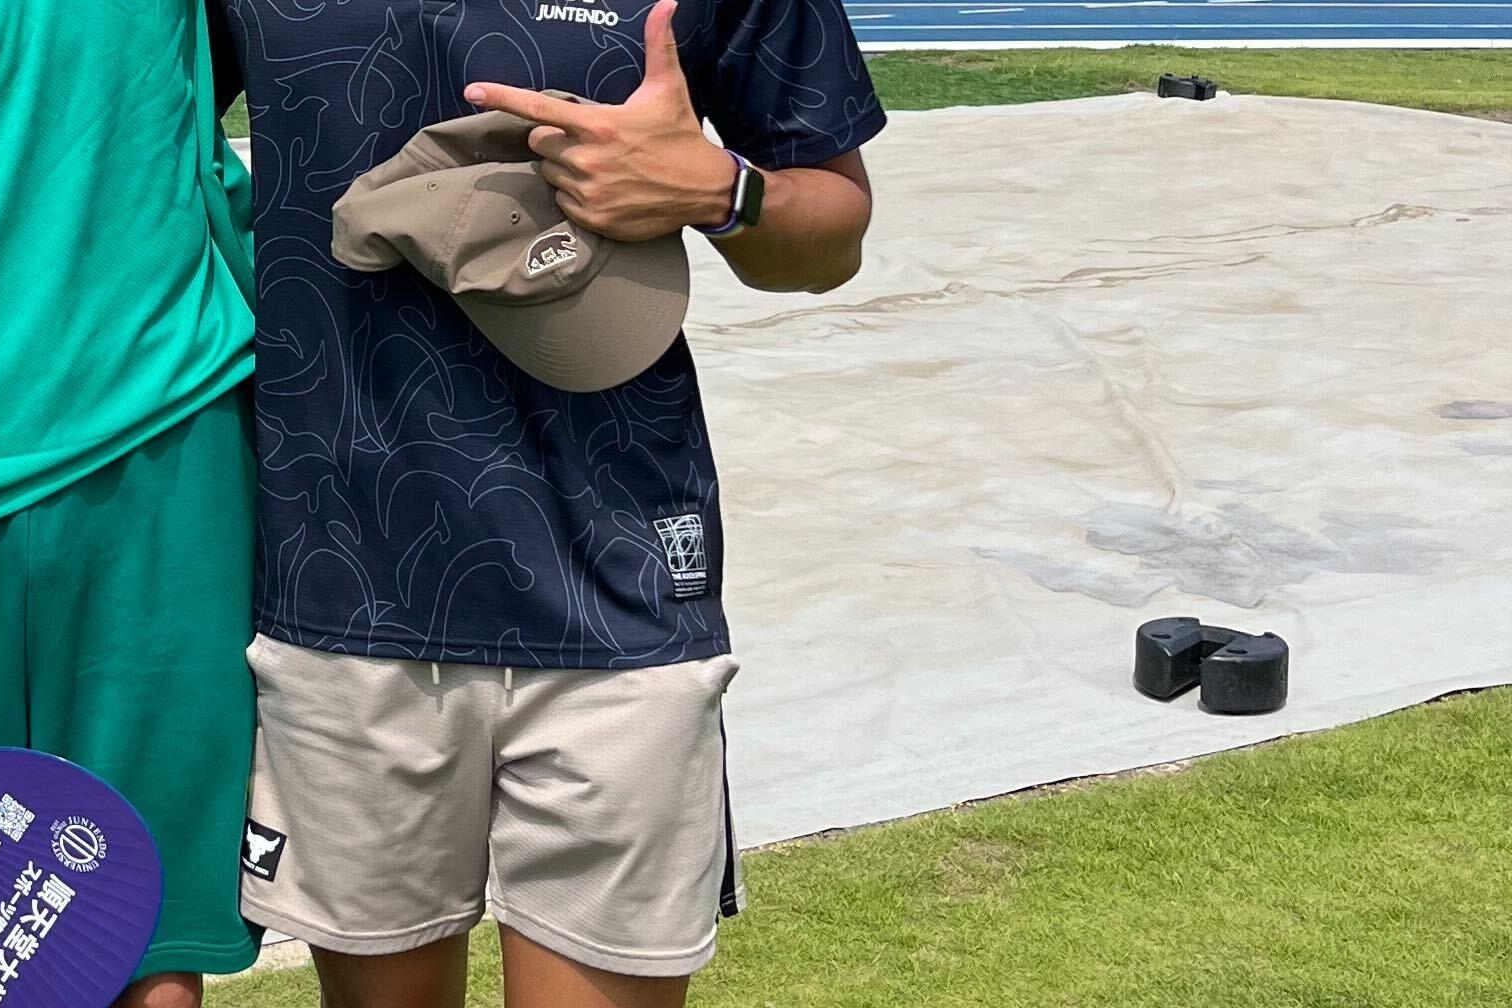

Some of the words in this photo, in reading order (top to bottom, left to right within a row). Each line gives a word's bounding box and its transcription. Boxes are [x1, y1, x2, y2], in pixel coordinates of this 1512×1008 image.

[535, 4, 620, 27] JUNTENDO
[104, 649, 157, 665] CHEMIST
[67, 815, 108, 859] JUNTENDO
[50, 839, 100, 873] UNIVERSITY
